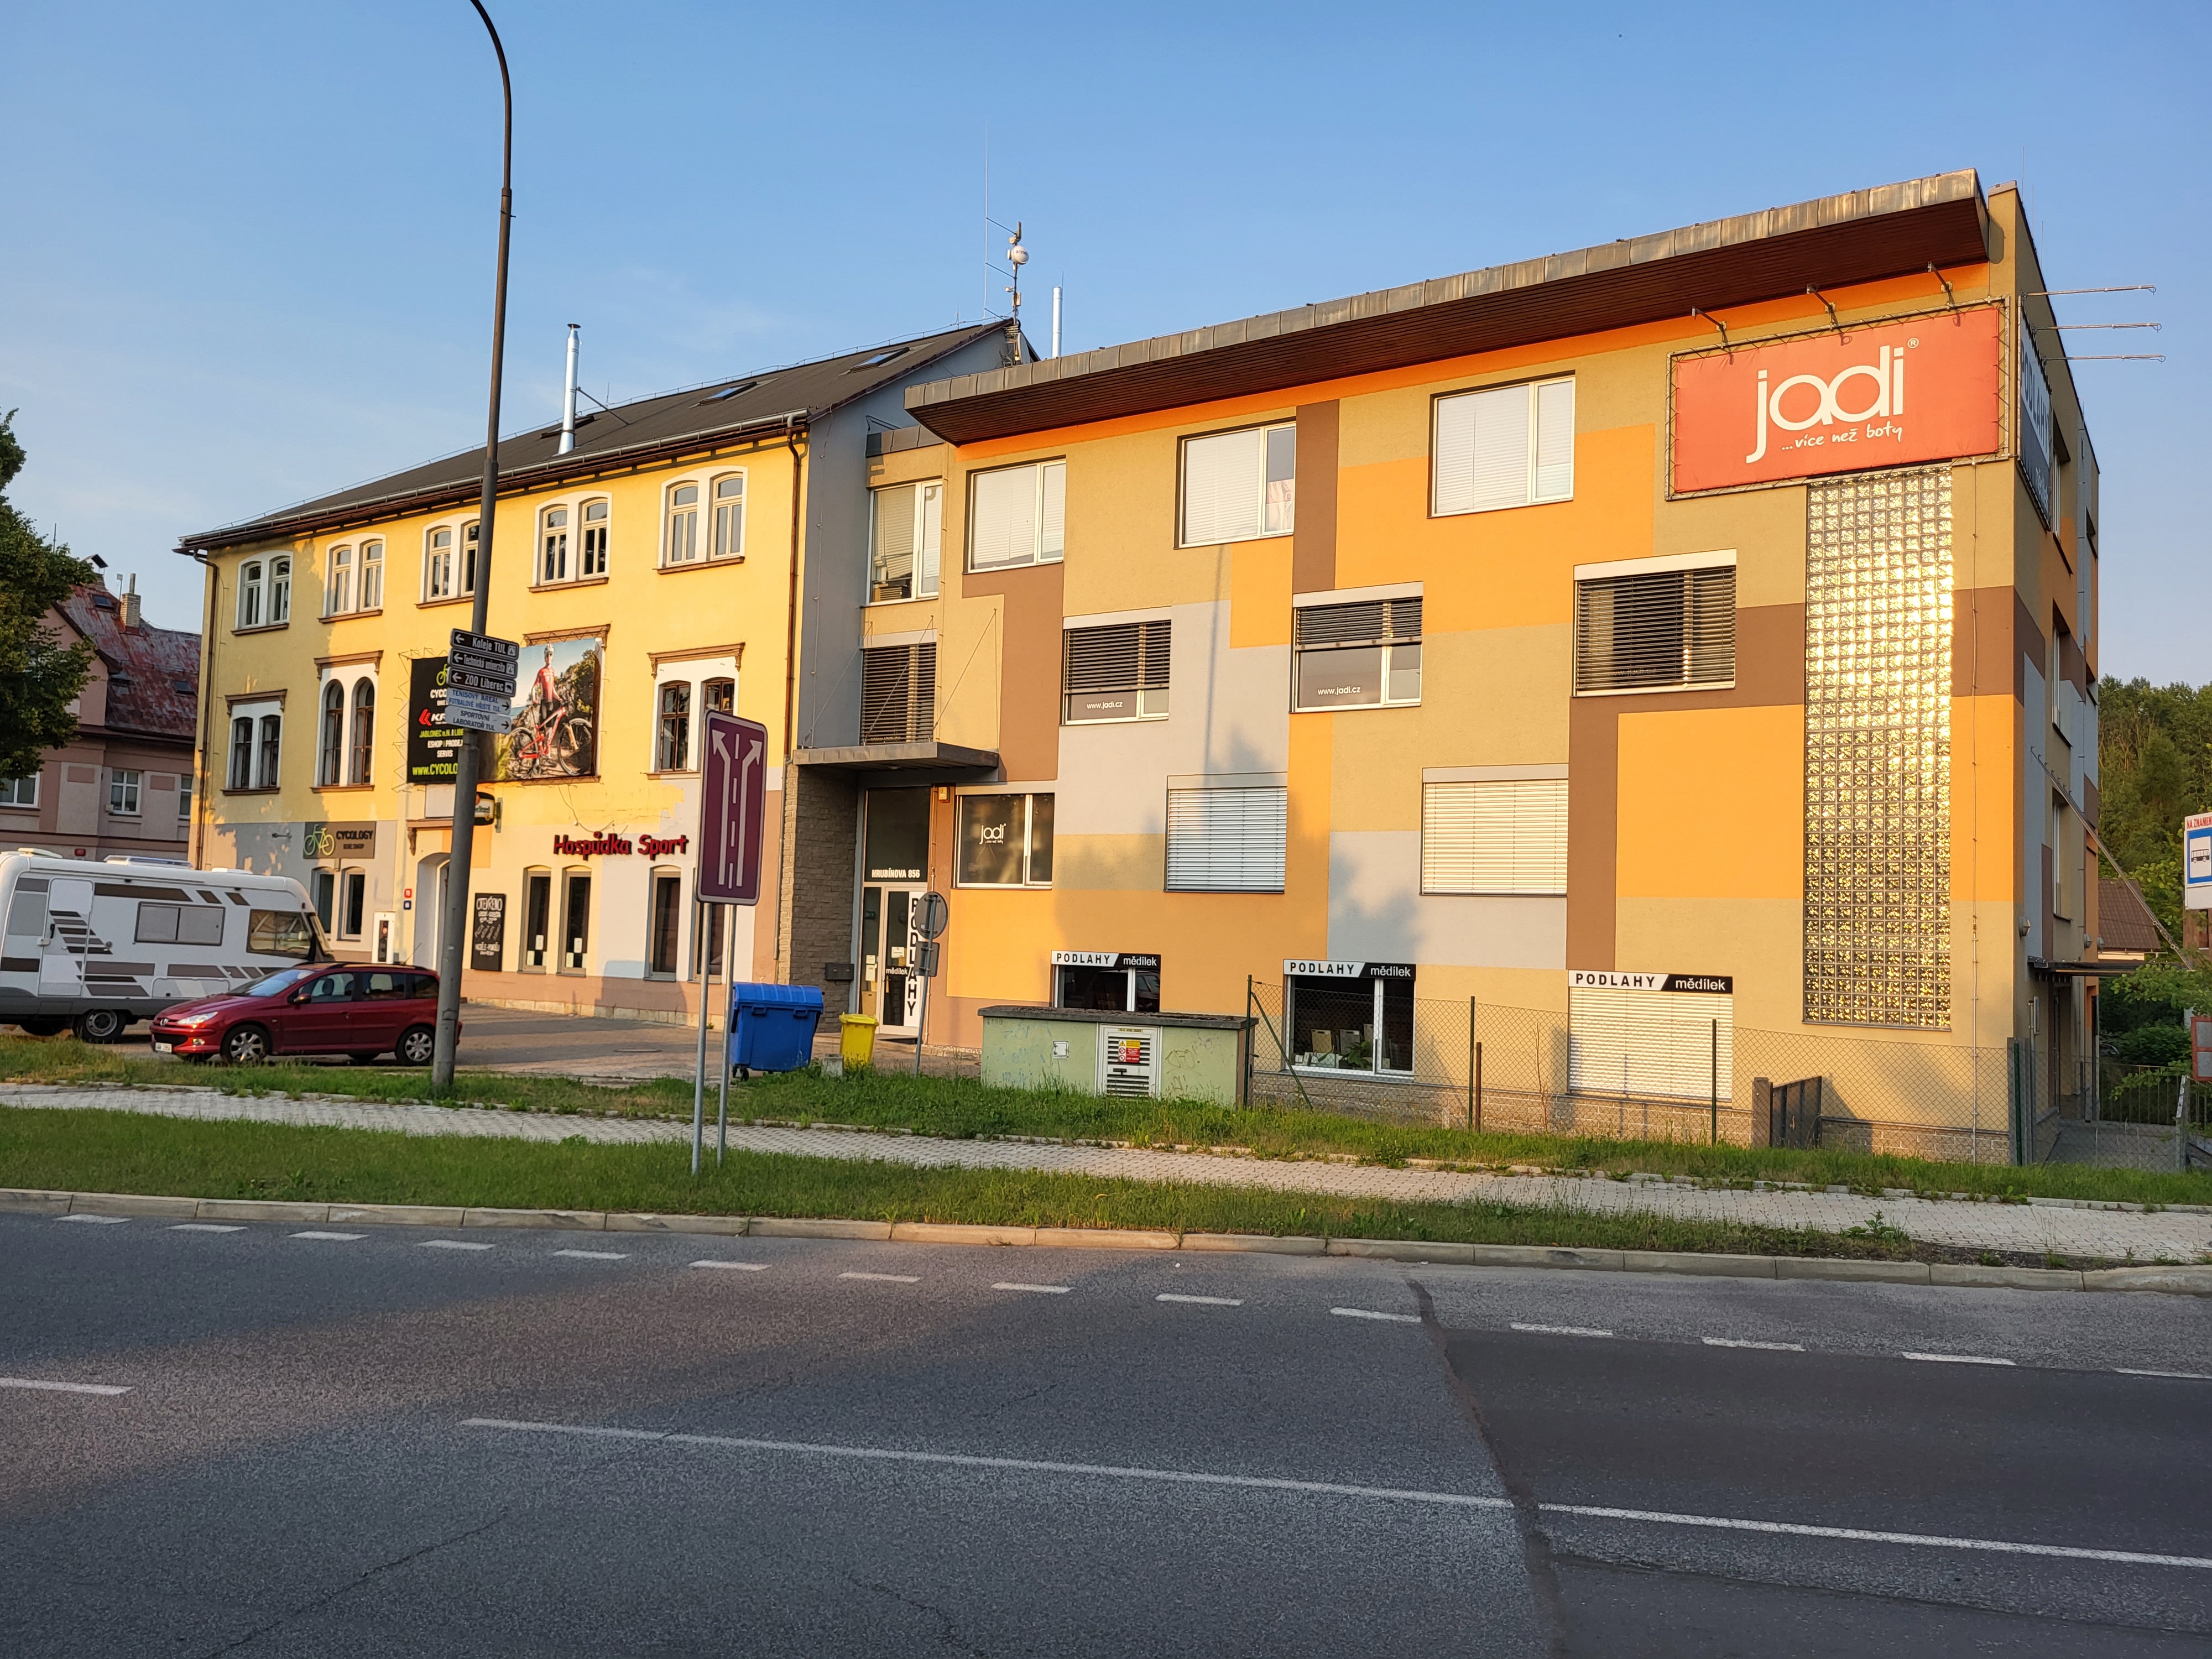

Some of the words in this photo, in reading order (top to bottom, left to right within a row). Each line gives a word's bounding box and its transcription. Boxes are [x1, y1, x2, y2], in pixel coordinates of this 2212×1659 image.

[1746, 345, 1905, 463] jadi
[1832, 428, 1858, 444] než
[1866, 421, 1903, 442] boty
[472, 637, 492, 651] Koleje
[494, 642, 506, 654] TUL
[465, 674, 479, 686] ZOO
[480, 677, 504, 691] Liberec
[430, 688, 447, 699] CYCO
[1317, 686, 1361, 696] www.jadi.cz
[1087, 701, 1123, 710] www.jadi.cz
[2187, 819, 2193, 829] NA
[2194, 816, 2212, 828] ZNAMEN
[336, 830, 373, 840] CYCOLOGY
[979, 823, 1004, 845] jadi
[553, 831, 632, 861] Hospůdka
[637, 834, 690, 861] Sport
[872, 867, 906, 878] HRUBÍNOVA
[907, 869, 920, 878] 856
[1056, 953, 1110, 964] PODLAHY
[1123, 956, 1157, 967] mědílek
[1290, 962, 1354, 974] PODLAHY
[1370, 966, 1411, 977] mědílek
[1575, 973, 1655, 988] PODLAHY
[1675, 977, 1726, 992] mědílek
